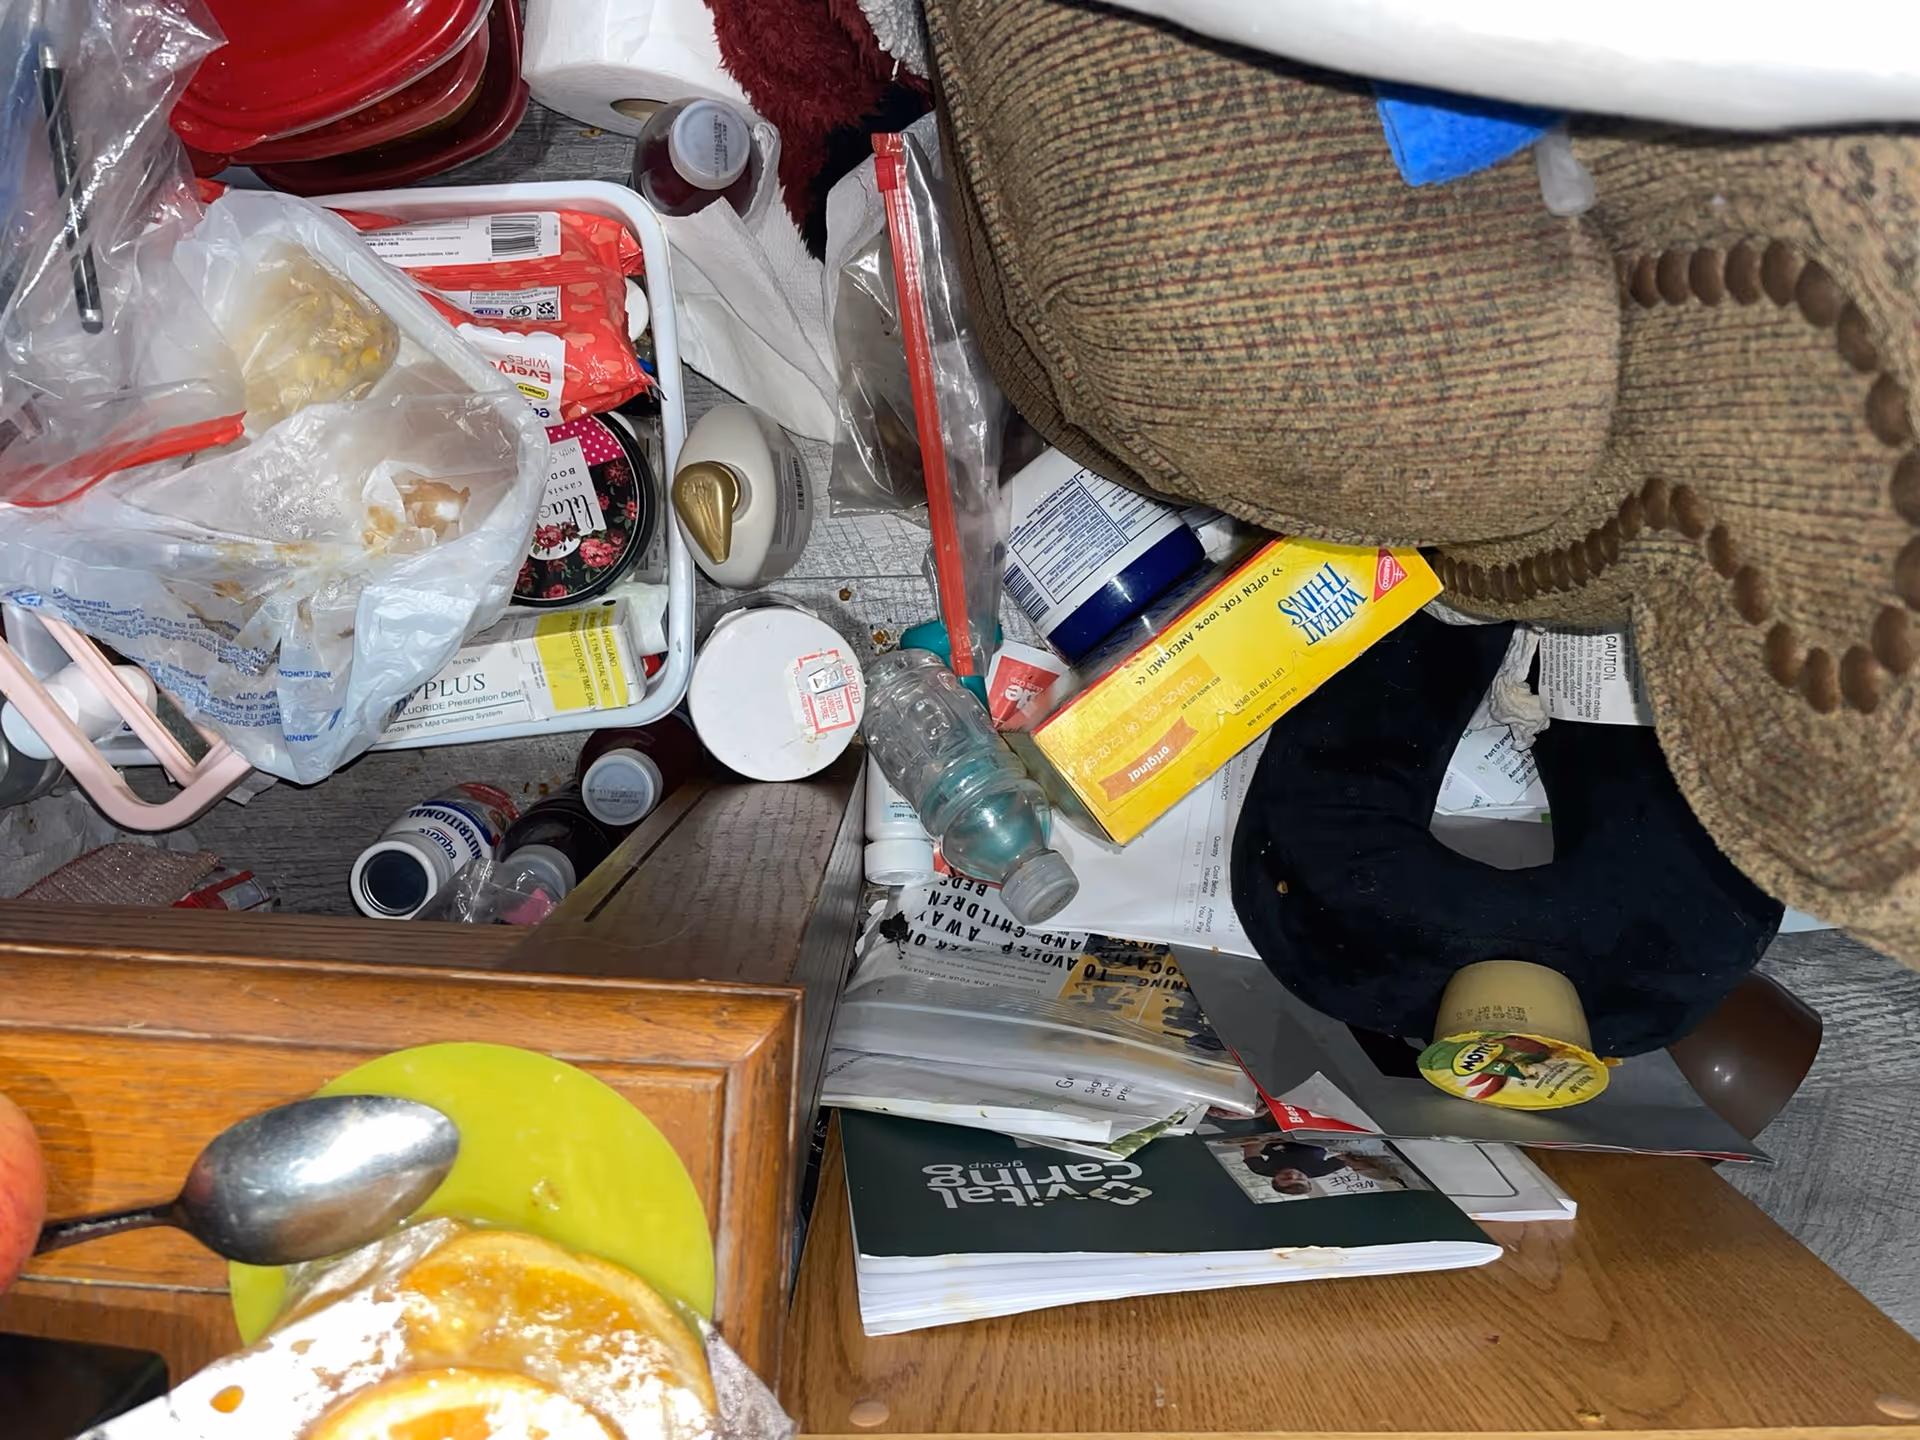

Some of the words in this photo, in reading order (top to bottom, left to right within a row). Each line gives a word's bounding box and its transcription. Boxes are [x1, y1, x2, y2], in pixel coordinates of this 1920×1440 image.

[507, 354, 550, 370] WIPES
[547, 467, 576, 482] BOD
[548, 480, 583, 496] cassis
[1379, 556, 1391, 590] NABISCO
[1240, 572, 1271, 599] OPEN
[1218, 592, 1243, 614] FOR
[1192, 608, 1221, 633] 100%
[1304, 586, 1368, 647] WHEAT
[463, 656, 481, 665] ONLY
[601, 633, 618, 667] HOLLAND
[1141, 630, 1198, 676] AWESOME!
[1603, 635, 1617, 681] CAUTION
[575, 657, 587, 674] ONE
[593, 652, 606, 678] DENTAL
[1271, 667, 1284, 679] LIFT
[424, 673, 486, 700] PLUS
[580, 674, 592, 692] TIME
[1249, 688, 1258, 696] TO
[1258, 677, 1271, 690] TAB
[1584, 683, 1592, 698] sharp
[402, 703, 445, 716] LUORIDE
[448, 694, 499, 710] Prescription
[501, 689, 522, 699] Dent
[825, 694, 839, 724] UMIDITY
[1234, 695, 1250, 709] OPEN
[1583, 698, 1591, 717] objects
[441, 714, 474, 725] Cleaning
[476, 710, 503, 720] System
[1125, 743, 1173, 784] original
[1484, 747, 1496, 760] Part
[1507, 758, 1527, 779] Amount
[1515, 772, 1528, 785] Your
[408, 807, 483, 860] NUTRITIONAL
[1211, 836, 1221, 858] Quantity
[1202, 867, 1211, 894] Insurance
[914, 910, 981, 942] AWAY
[1206, 907, 1215, 933] Amount
[1041, 932, 1082, 951] AND
[947, 974, 970, 983] YOUR
[1288, 1104, 1305, 1124] Bes
[922, 1161, 1143, 1188] caring
[968, 1159, 1024, 1169] group
[927, 1184, 1088, 1209] vital
